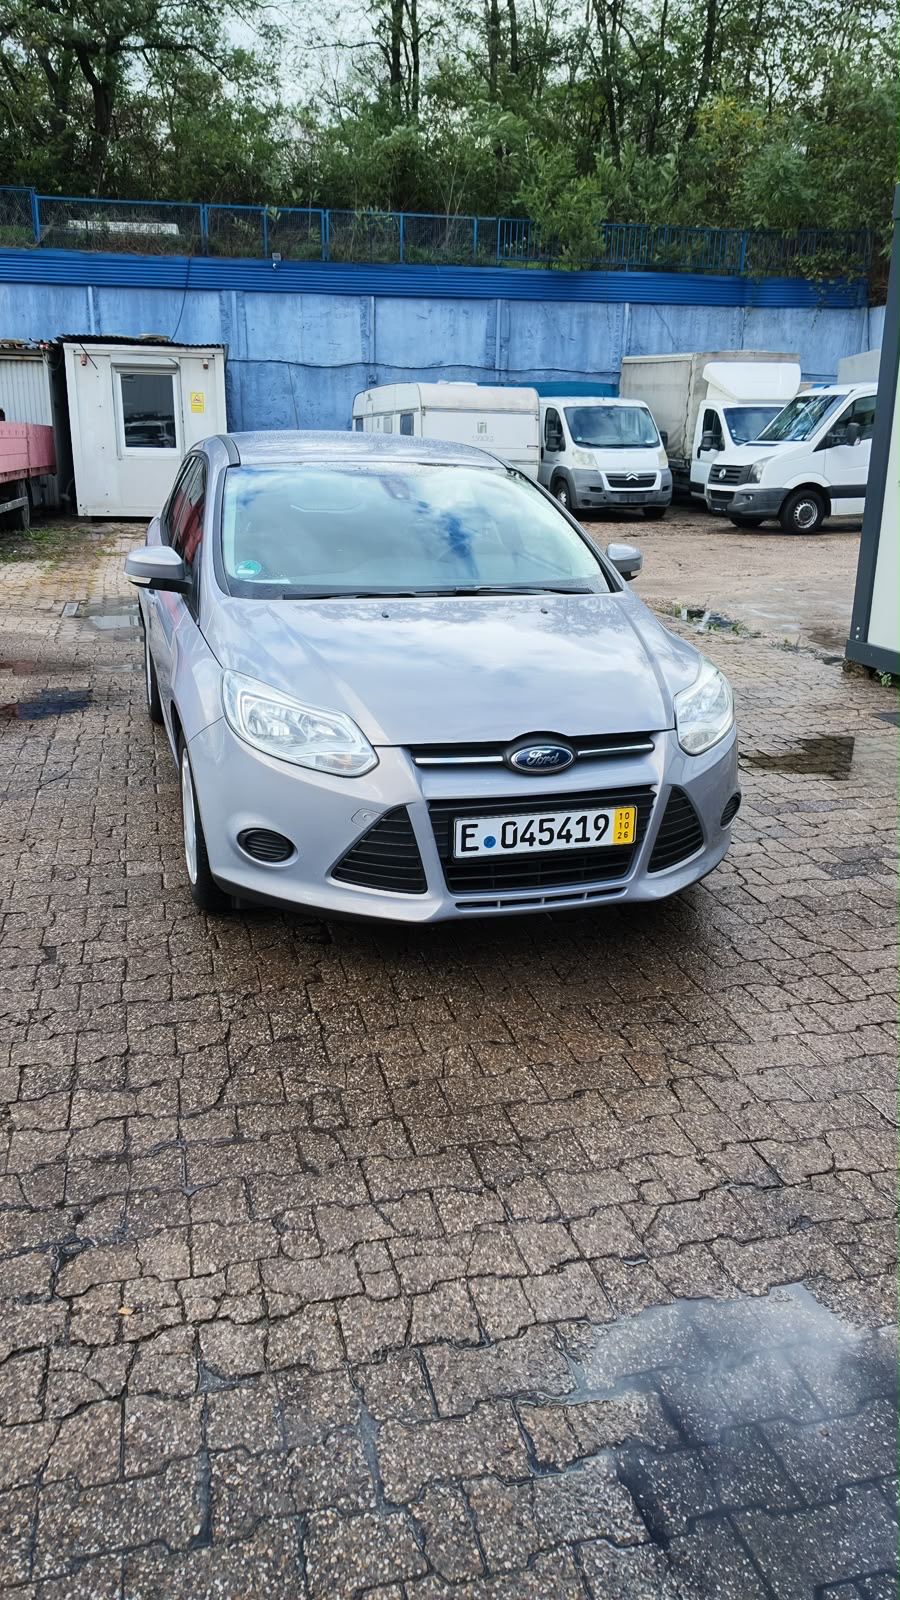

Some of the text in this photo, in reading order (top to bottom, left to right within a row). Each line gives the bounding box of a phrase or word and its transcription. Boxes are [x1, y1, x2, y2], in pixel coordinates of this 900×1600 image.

[527, 750, 559, 765] Ford
[619, 812, 630, 820] 10
[619, 821, 630, 829] 10
[461, 814, 610, 852] E 045419
[617, 831, 629, 839] 26
